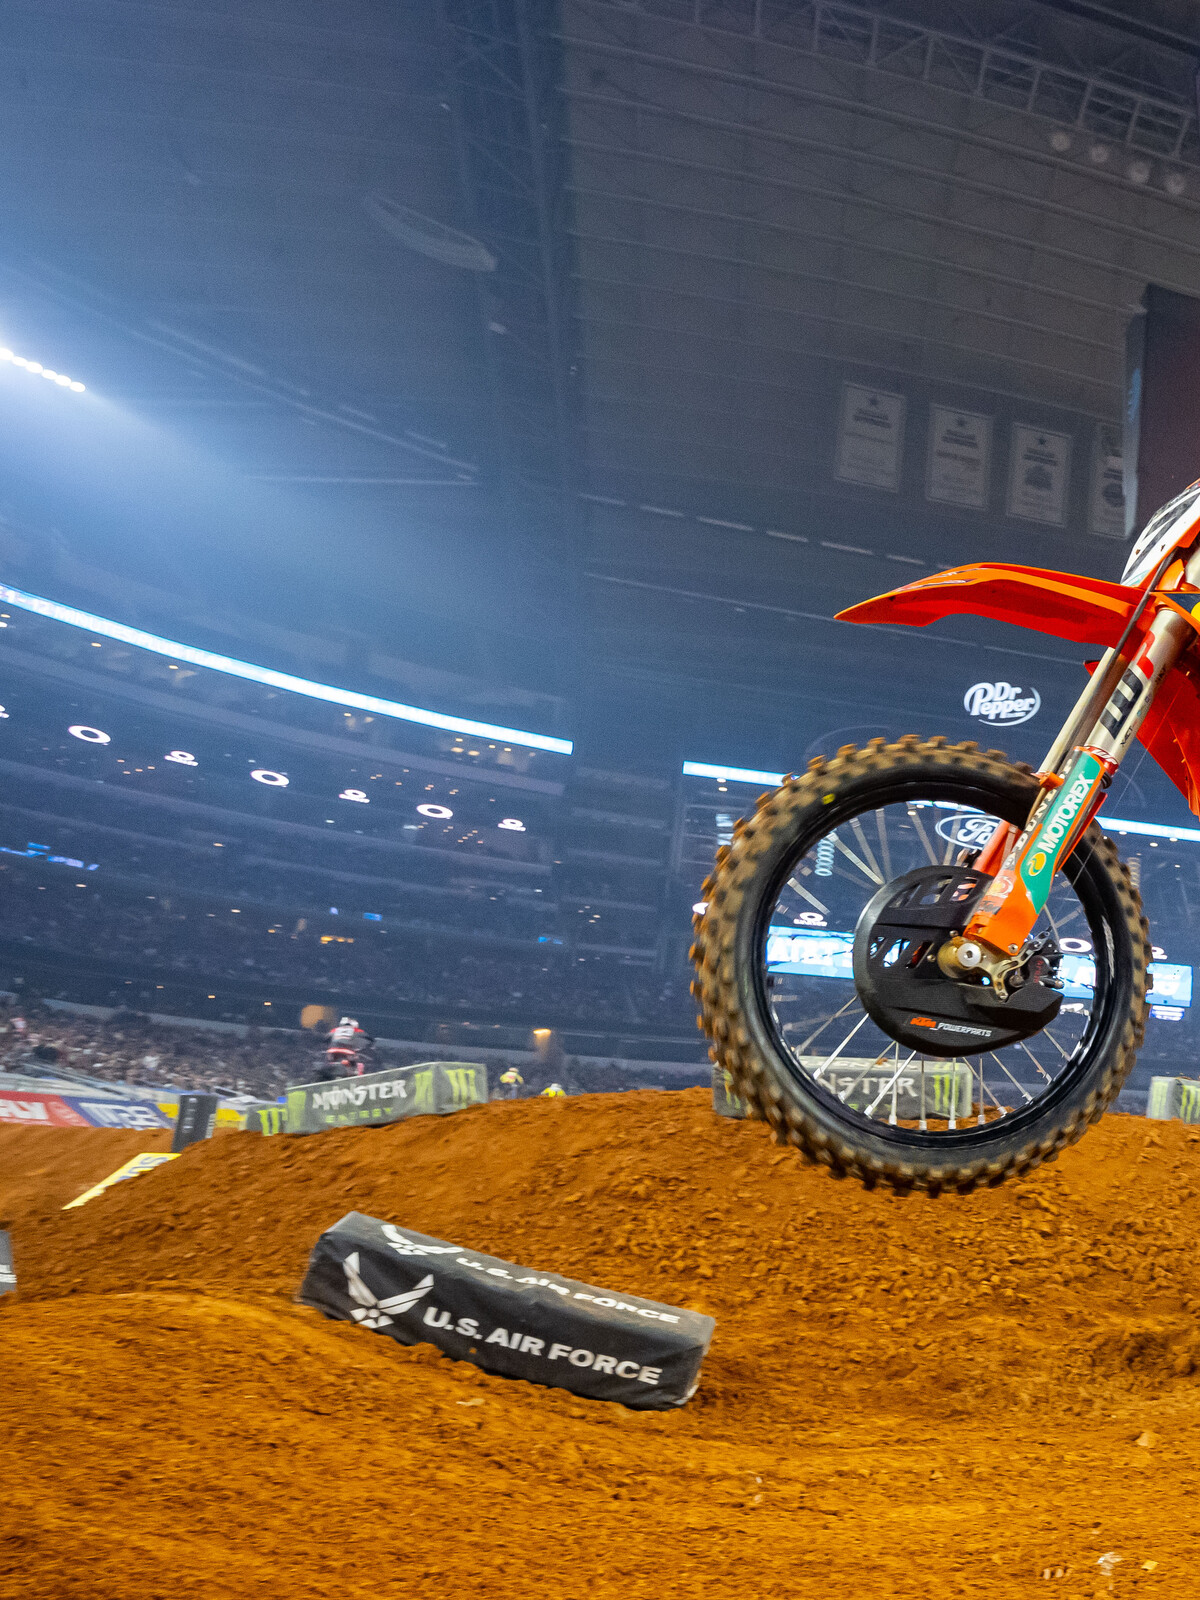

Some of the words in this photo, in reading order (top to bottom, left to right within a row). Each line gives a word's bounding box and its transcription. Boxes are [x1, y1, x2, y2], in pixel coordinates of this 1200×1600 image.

[964, 682, 1036, 720] Pepper
[992, 681, 1022, 701] Dr
[1037, 773, 1095, 854] MOTOREX
[514, 1276, 571, 1297] AIR
[572, 1291, 682, 1325] FORCE
[422, 1306, 484, 1340] U.S.
[484, 1327, 547, 1358] AIR
[547, 1342, 664, 1386] FORCE
